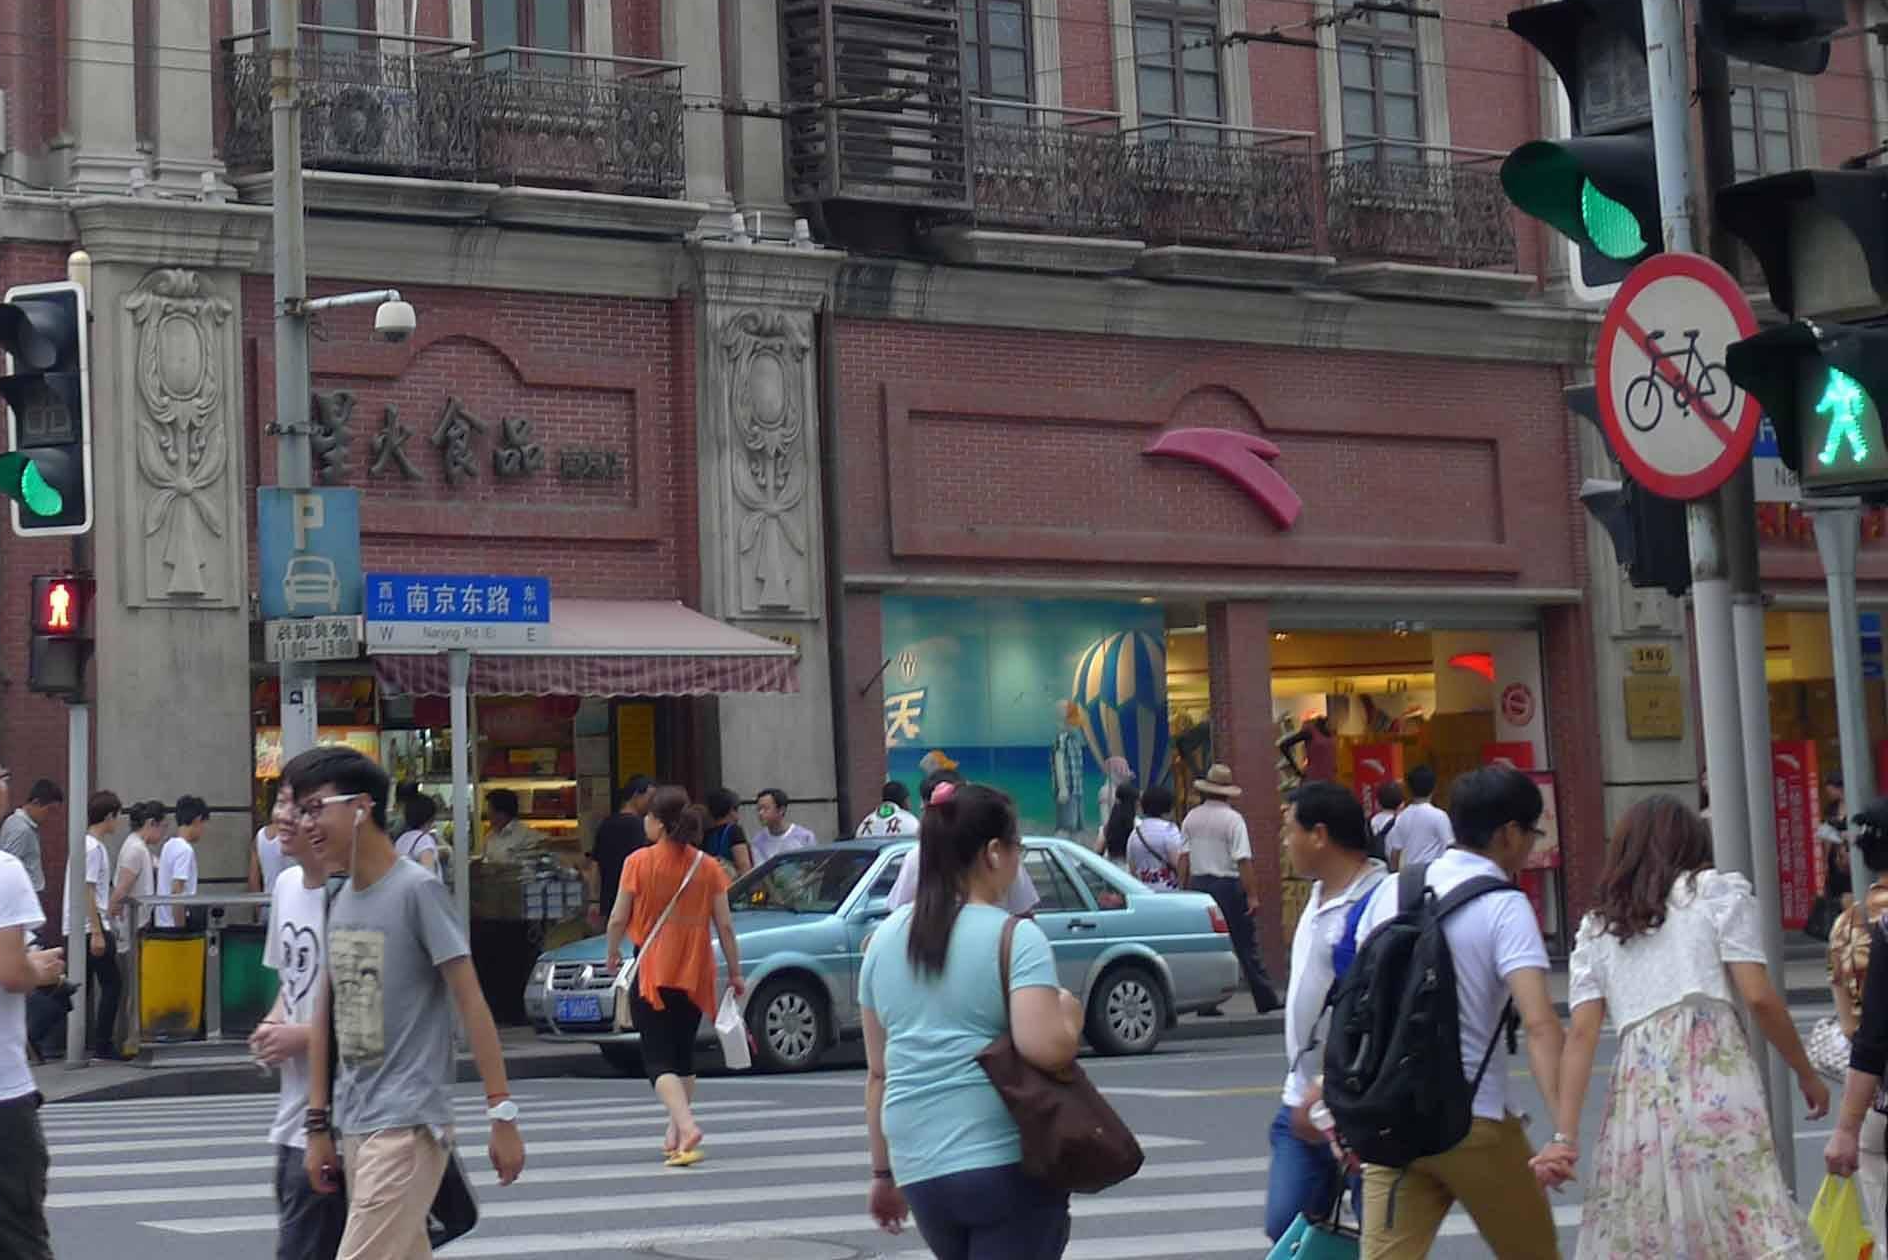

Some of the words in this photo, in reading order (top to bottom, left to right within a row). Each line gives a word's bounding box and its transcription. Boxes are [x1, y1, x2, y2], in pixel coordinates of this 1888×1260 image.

[292, 494, 325, 551] P
[406, 583, 511, 616] 南京东路
[527, 627, 537, 642] E
